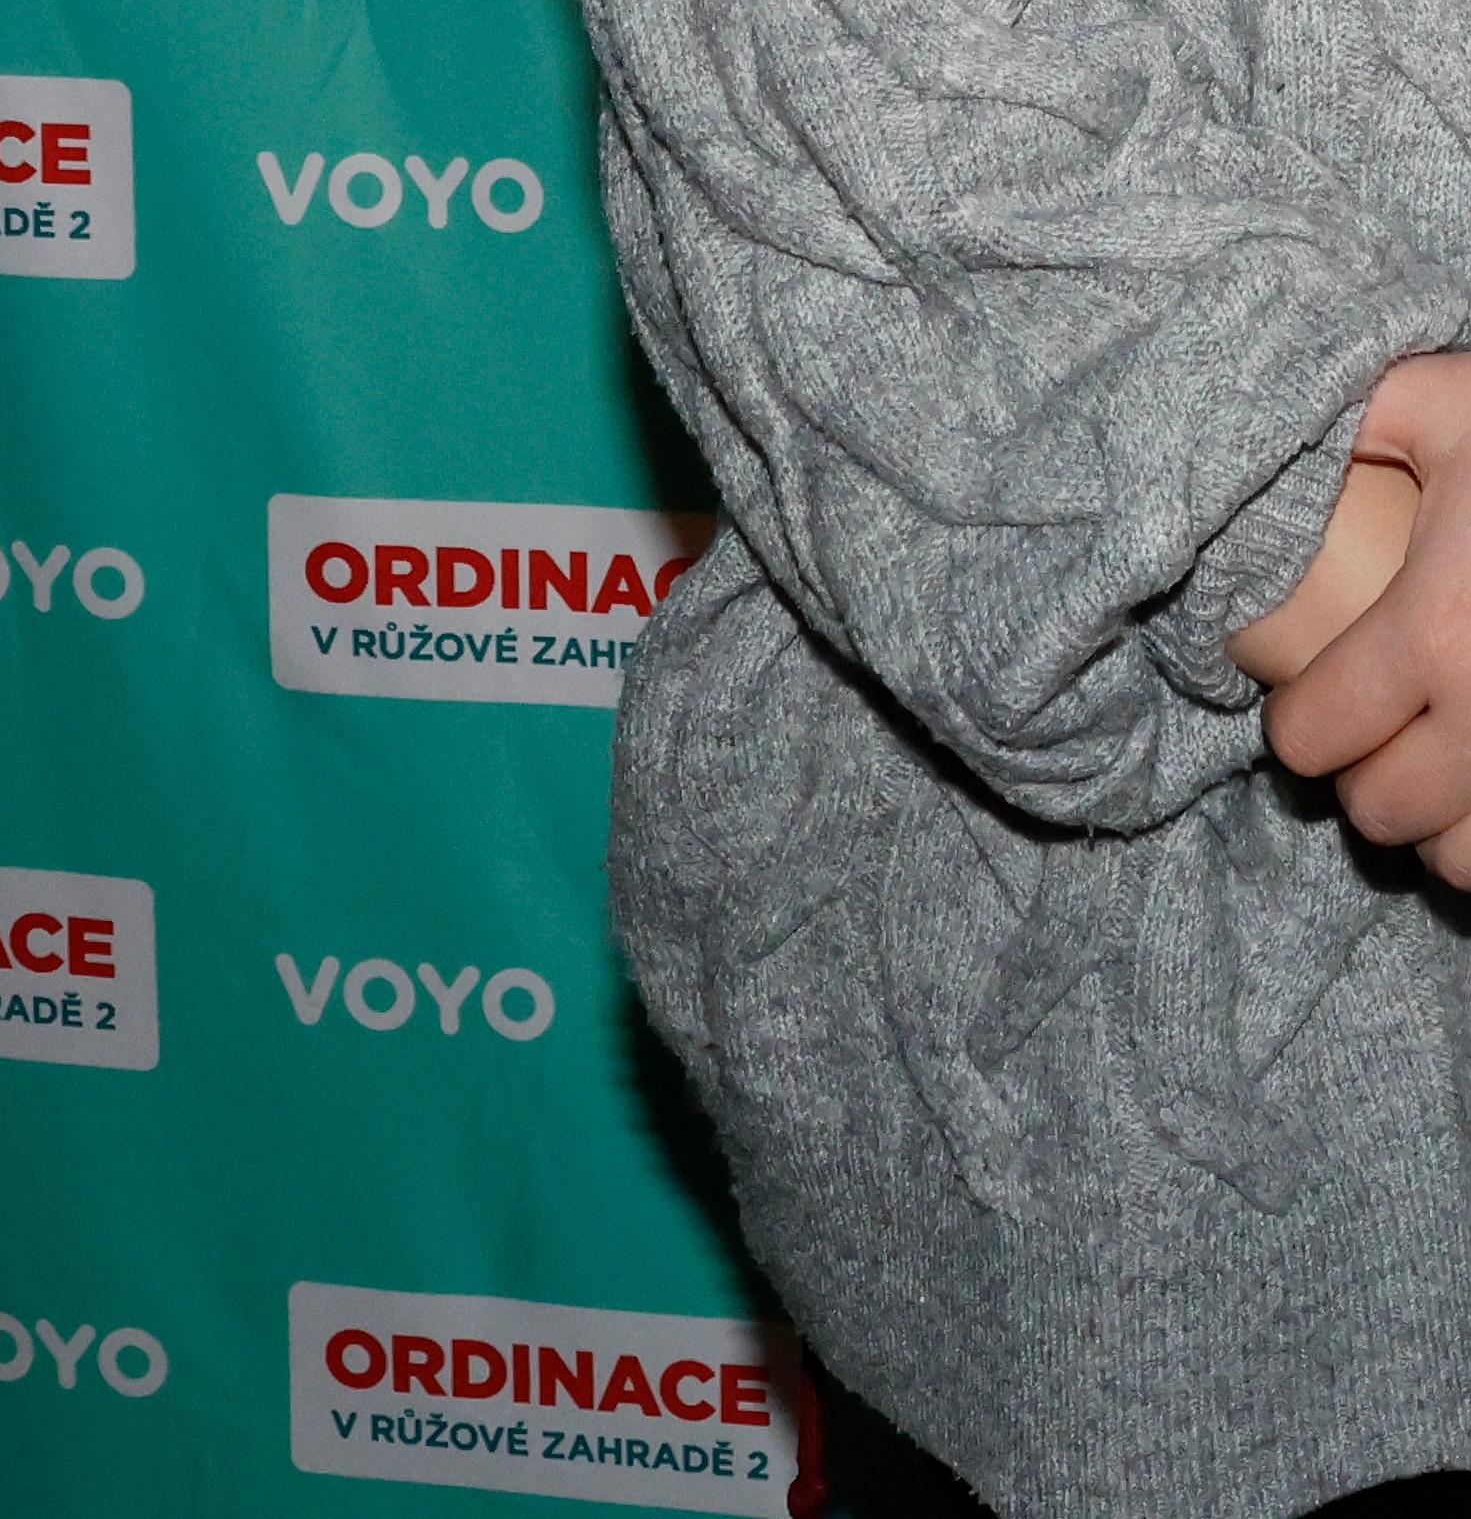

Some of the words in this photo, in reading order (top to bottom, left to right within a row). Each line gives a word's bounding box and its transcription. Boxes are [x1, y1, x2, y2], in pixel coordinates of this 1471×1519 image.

[68, 209, 92, 241] 2
[257, 151, 544, 232] VOYO
[95, 1000, 117, 1032] 2
[275, 953, 555, 1041] VOYO
[327, 1330, 770, 1427] ORDINACE
